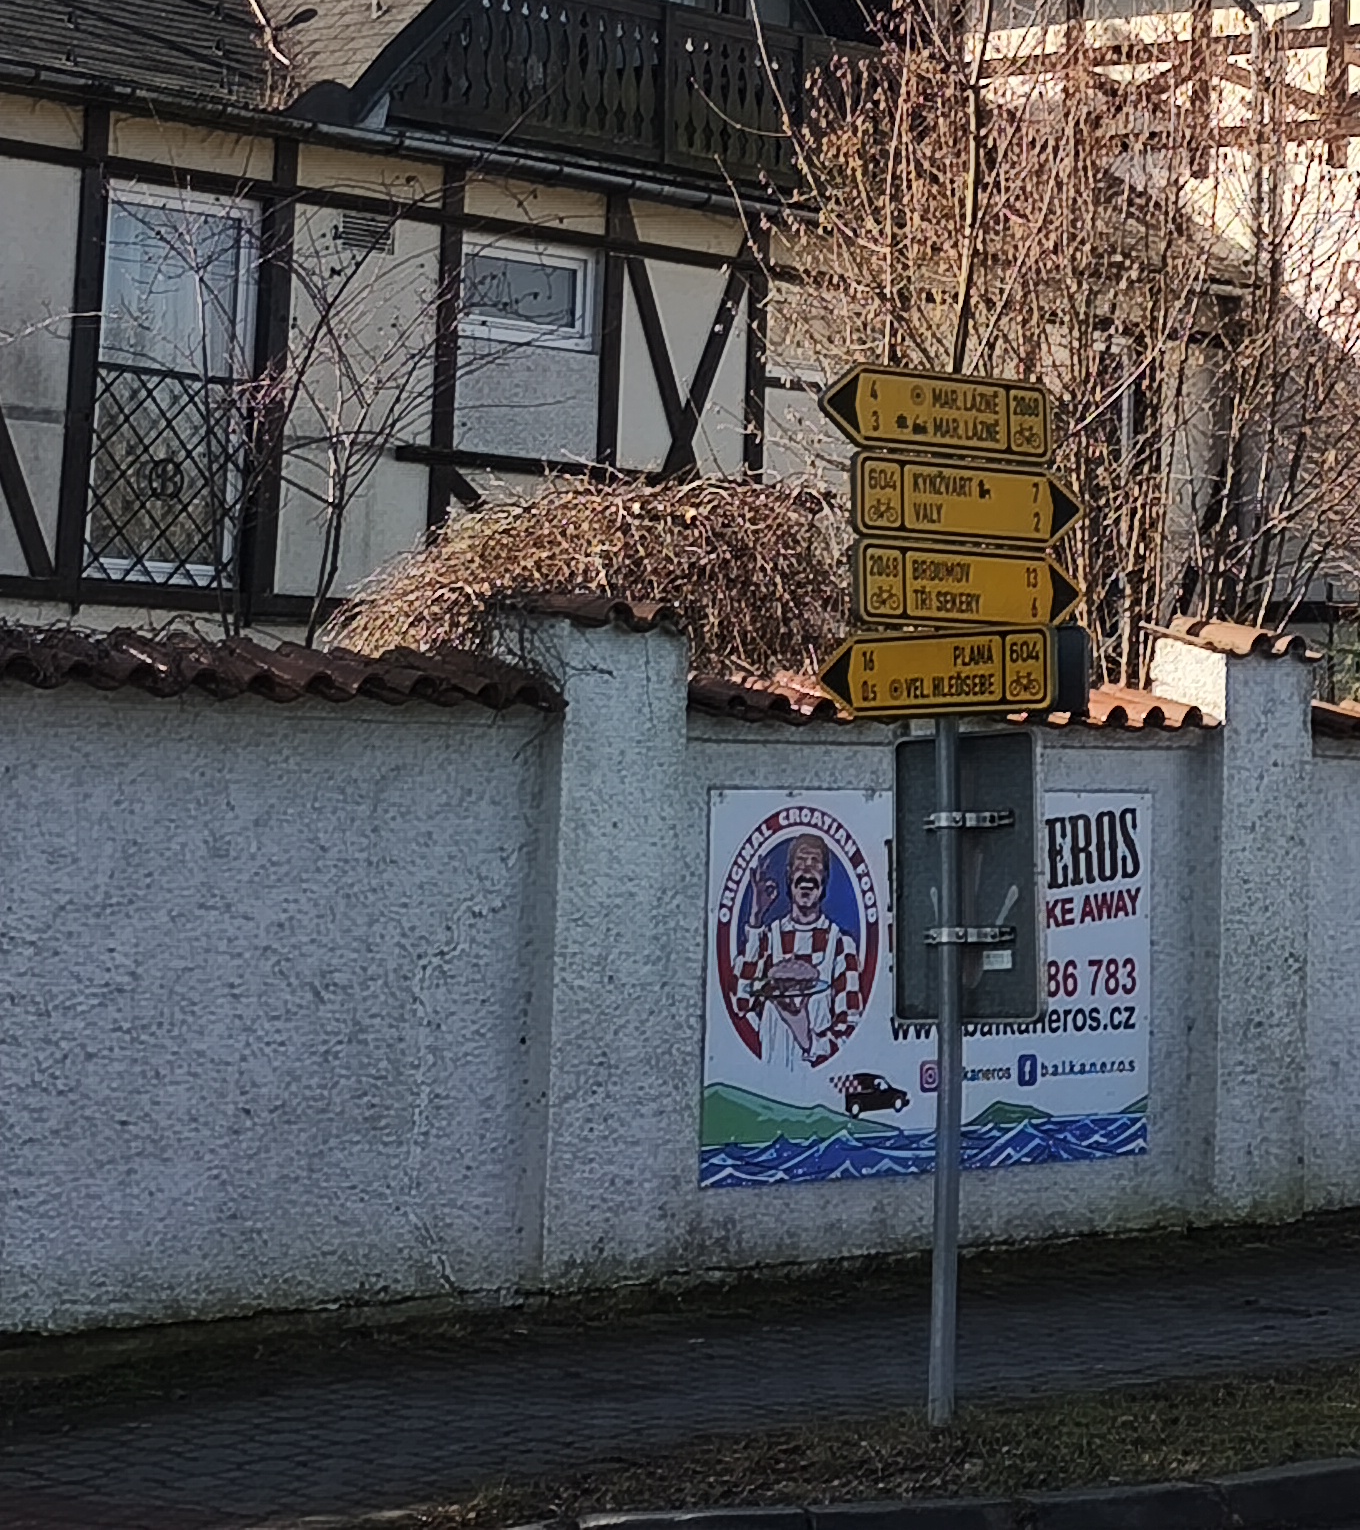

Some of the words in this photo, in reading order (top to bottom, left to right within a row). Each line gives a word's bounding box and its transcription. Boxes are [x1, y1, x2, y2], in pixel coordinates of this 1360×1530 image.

[872, 410, 880, 432] 3
[868, 468, 897, 491] 604
[1032, 482, 1040, 504] 7
[913, 501, 943, 524] VALY
[1033, 511, 1041, 533] 2
[1025, 566, 1039, 589] 13
[936, 590, 982, 615] SEKERY
[1031, 596, 1039, 618] 6
[862, 650, 875, 672] 16
[953, 639, 994, 667] PLANÁ
[1009, 640, 1040, 664] 604
[778, 808, 857, 858] CROATIAN
[1045, 808, 1140, 889] EROS
[718, 823, 773, 923] ORIGINAL
[856, 862, 877, 923] FOOD
[1046, 897, 1076, 930] KE
[1080, 887, 1141, 924] AWAY
[1047, 959, 1078, 998] 86
[1088, 957, 1137, 996] 783
[1041, 1058, 1136, 1077] balkaneros
